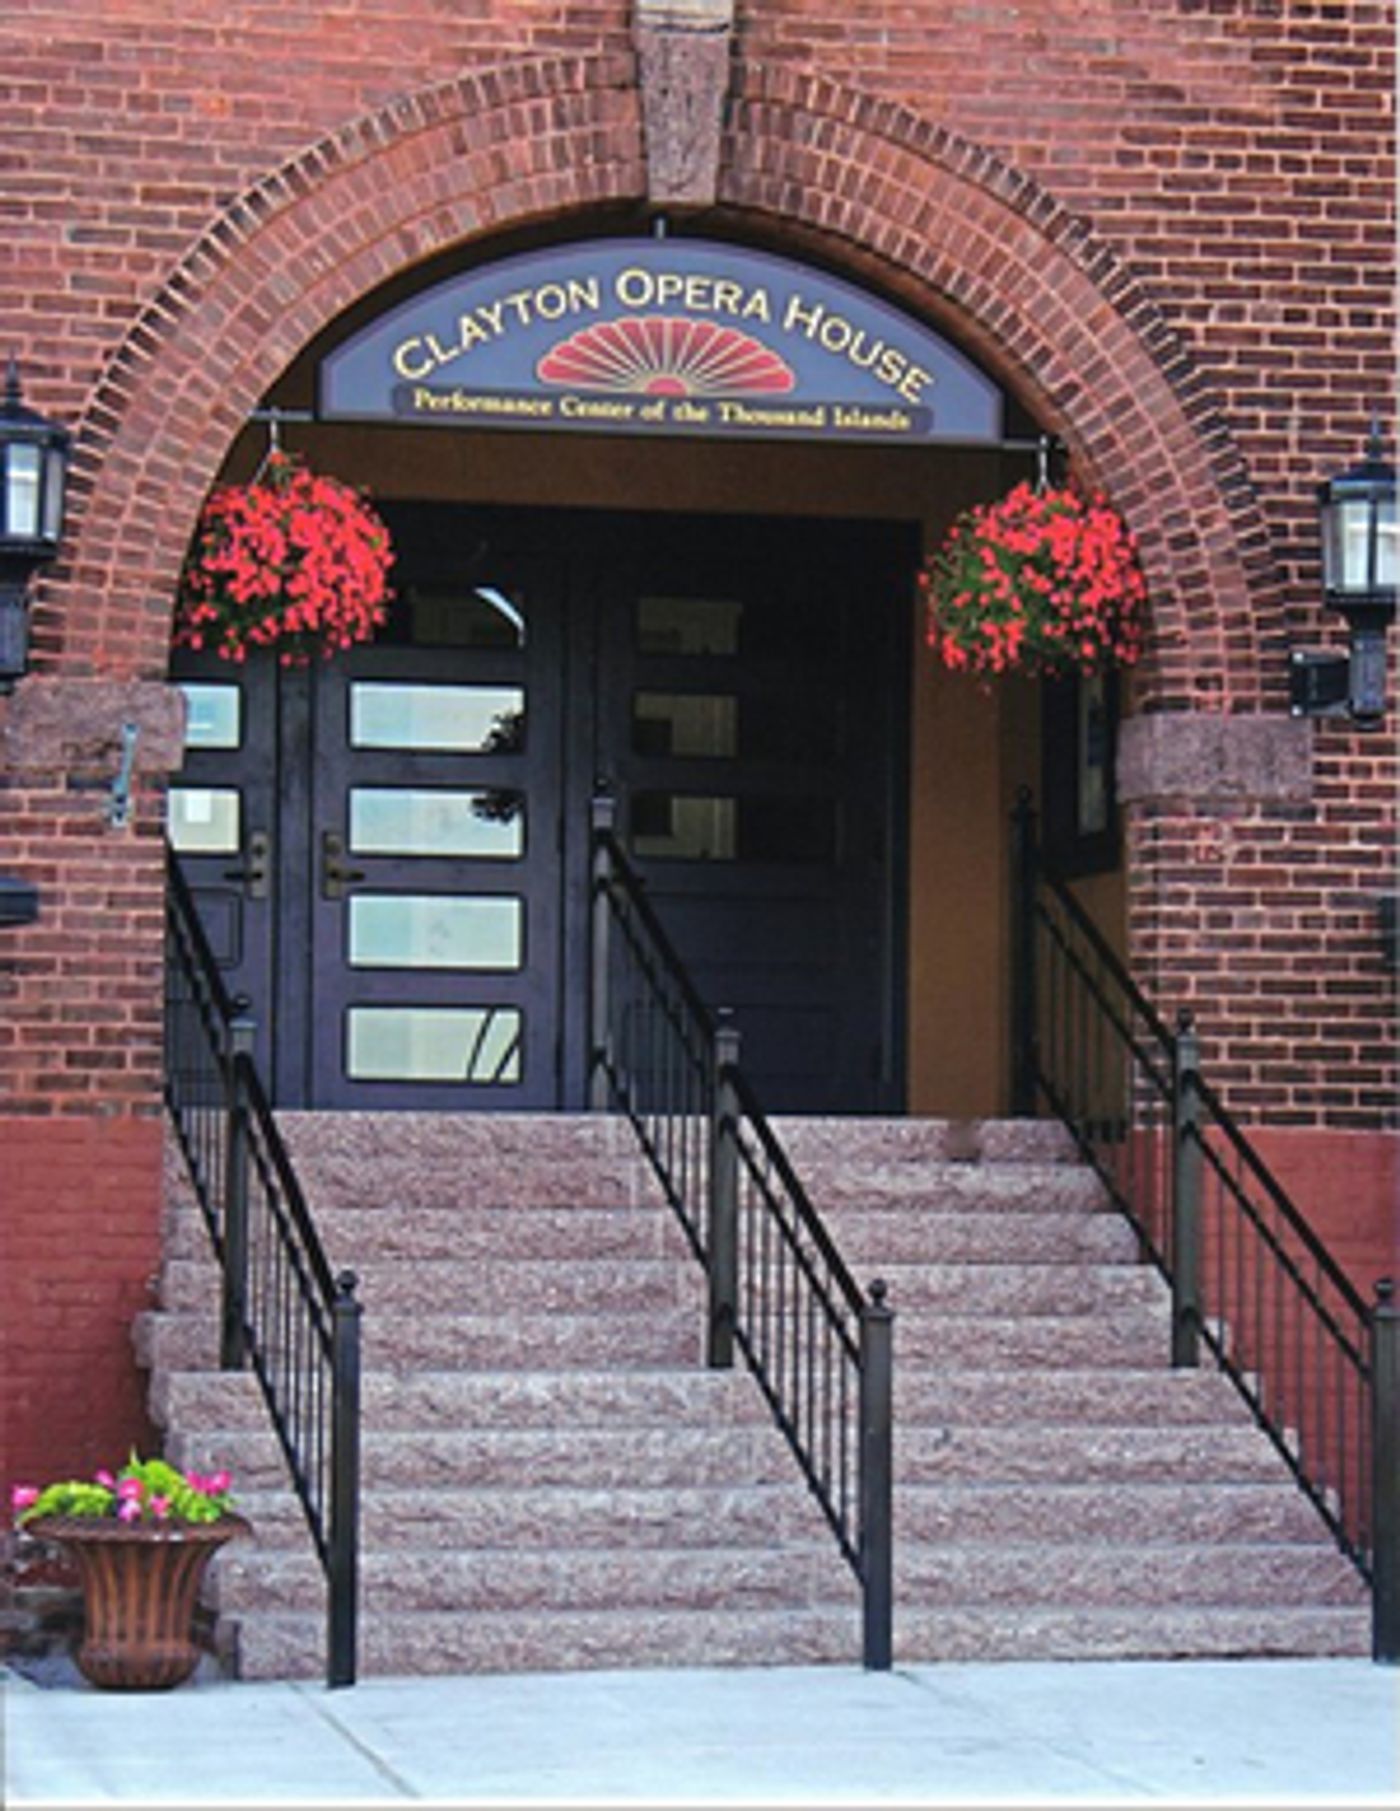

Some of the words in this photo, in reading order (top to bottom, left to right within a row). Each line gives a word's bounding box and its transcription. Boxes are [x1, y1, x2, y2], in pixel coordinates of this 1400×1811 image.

[393, 277, 600, 380] CLAYTON
[616, 268, 770, 322] OPERA
[784, 295, 934, 404] HOUSE
[414, 389, 552, 416] Performance
[560, 396, 634, 420] Center
[641, 400, 666, 420] of
[673, 399, 709, 423] the
[719, 402, 826, 427] Thousand
[835, 406, 910, 430] Islands
